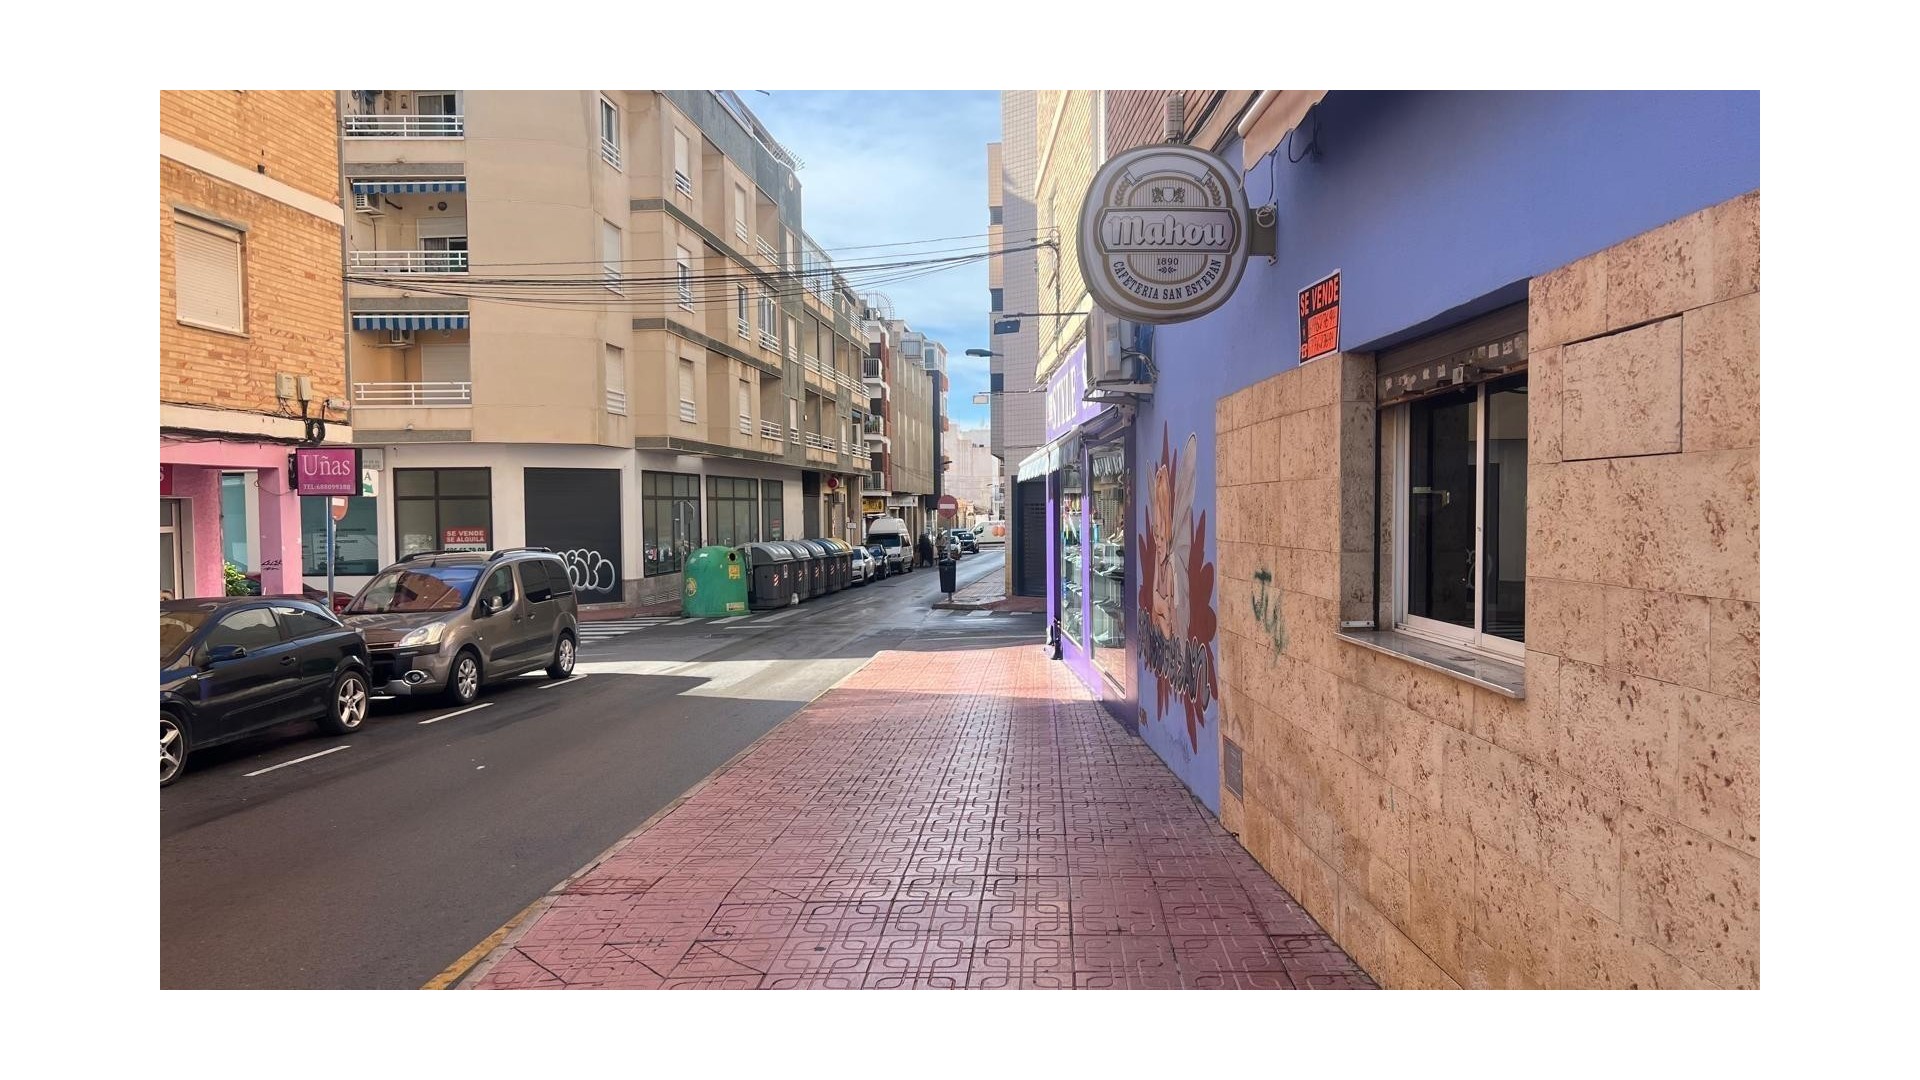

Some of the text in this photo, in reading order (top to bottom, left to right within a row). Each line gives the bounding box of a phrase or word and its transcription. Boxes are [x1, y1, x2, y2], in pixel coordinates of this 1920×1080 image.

[1110, 214, 1226, 246] Mahou
[1157, 258, 1179, 266] 1890
[1113, 260, 1222, 300] CAFETERIA SAN ESTEBAN
[1300, 276, 1339, 317] SE VENDE
[301, 454, 351, 476] Uñas
